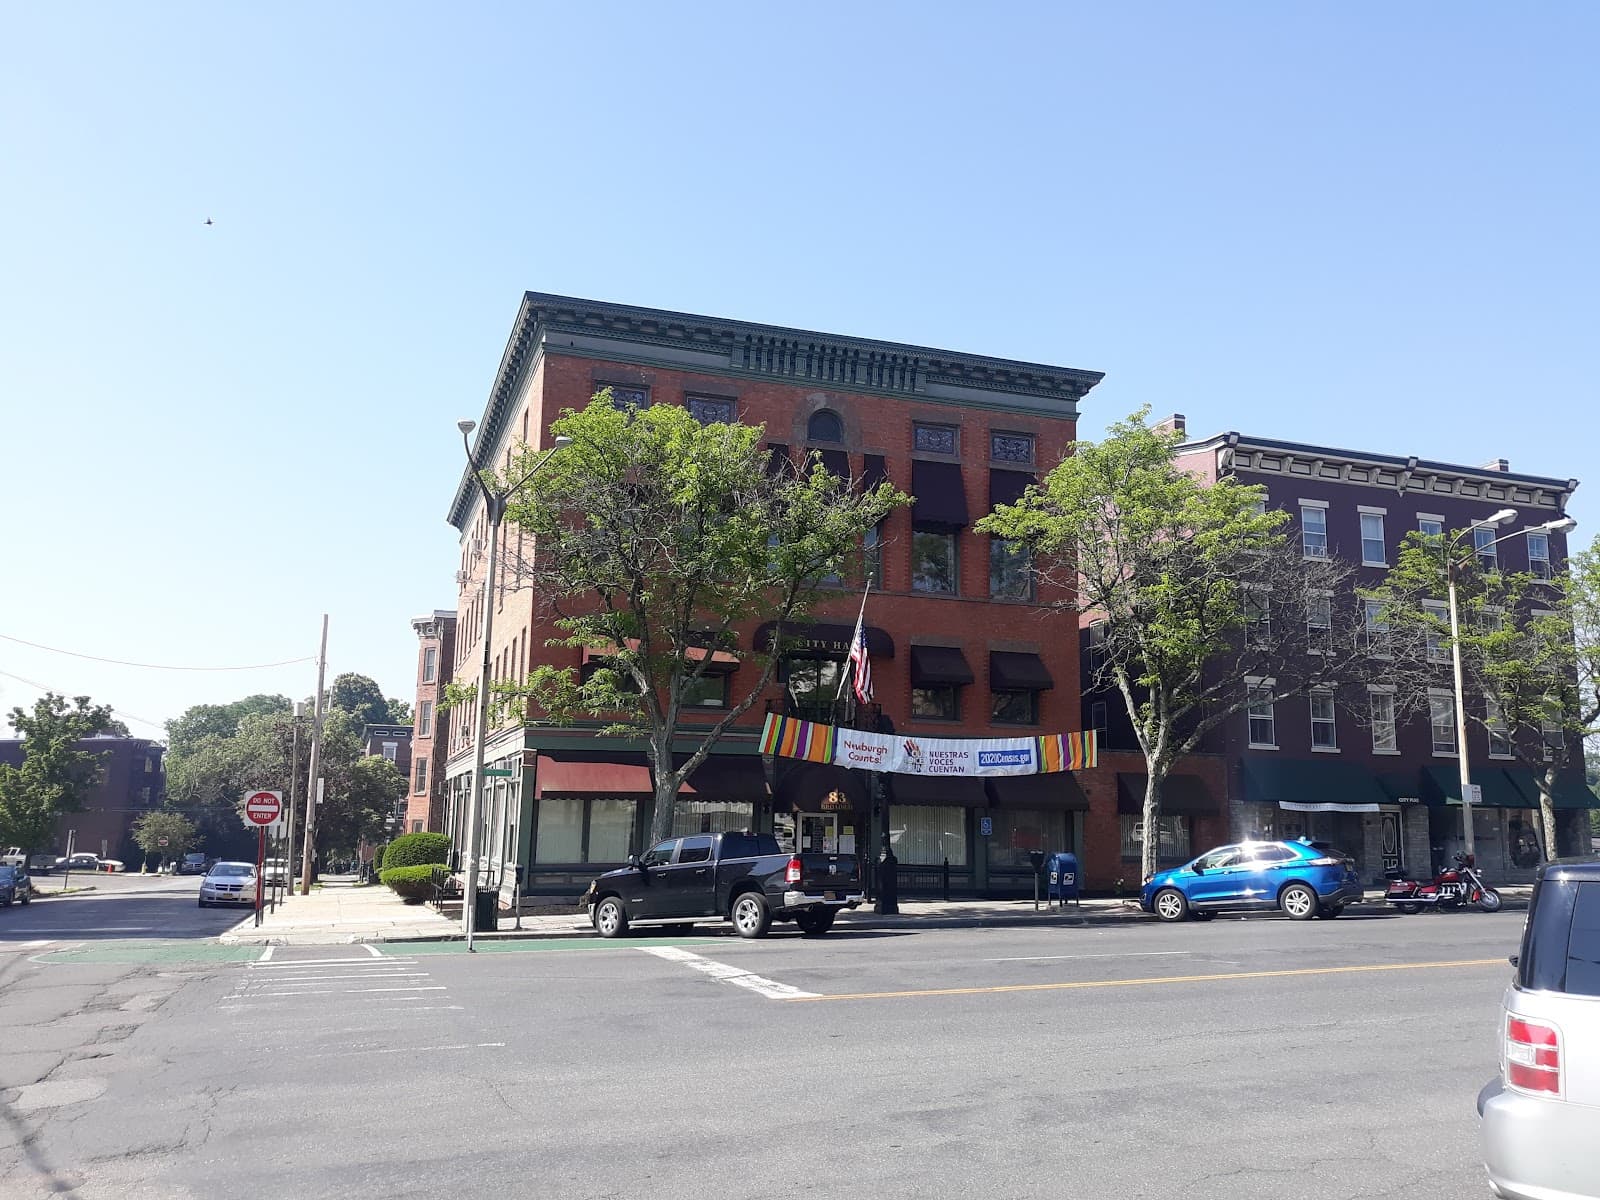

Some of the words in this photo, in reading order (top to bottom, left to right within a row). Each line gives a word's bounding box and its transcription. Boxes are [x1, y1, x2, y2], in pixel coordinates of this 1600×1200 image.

[797, 639, 828, 649] CITY
[848, 751, 882, 764] Counts!
[929, 751, 969, 760] NUESTRAS
[929, 758, 954, 766] VOCES
[928, 765, 965, 773] CUENTAN
[828, 791, 847, 803] 83
